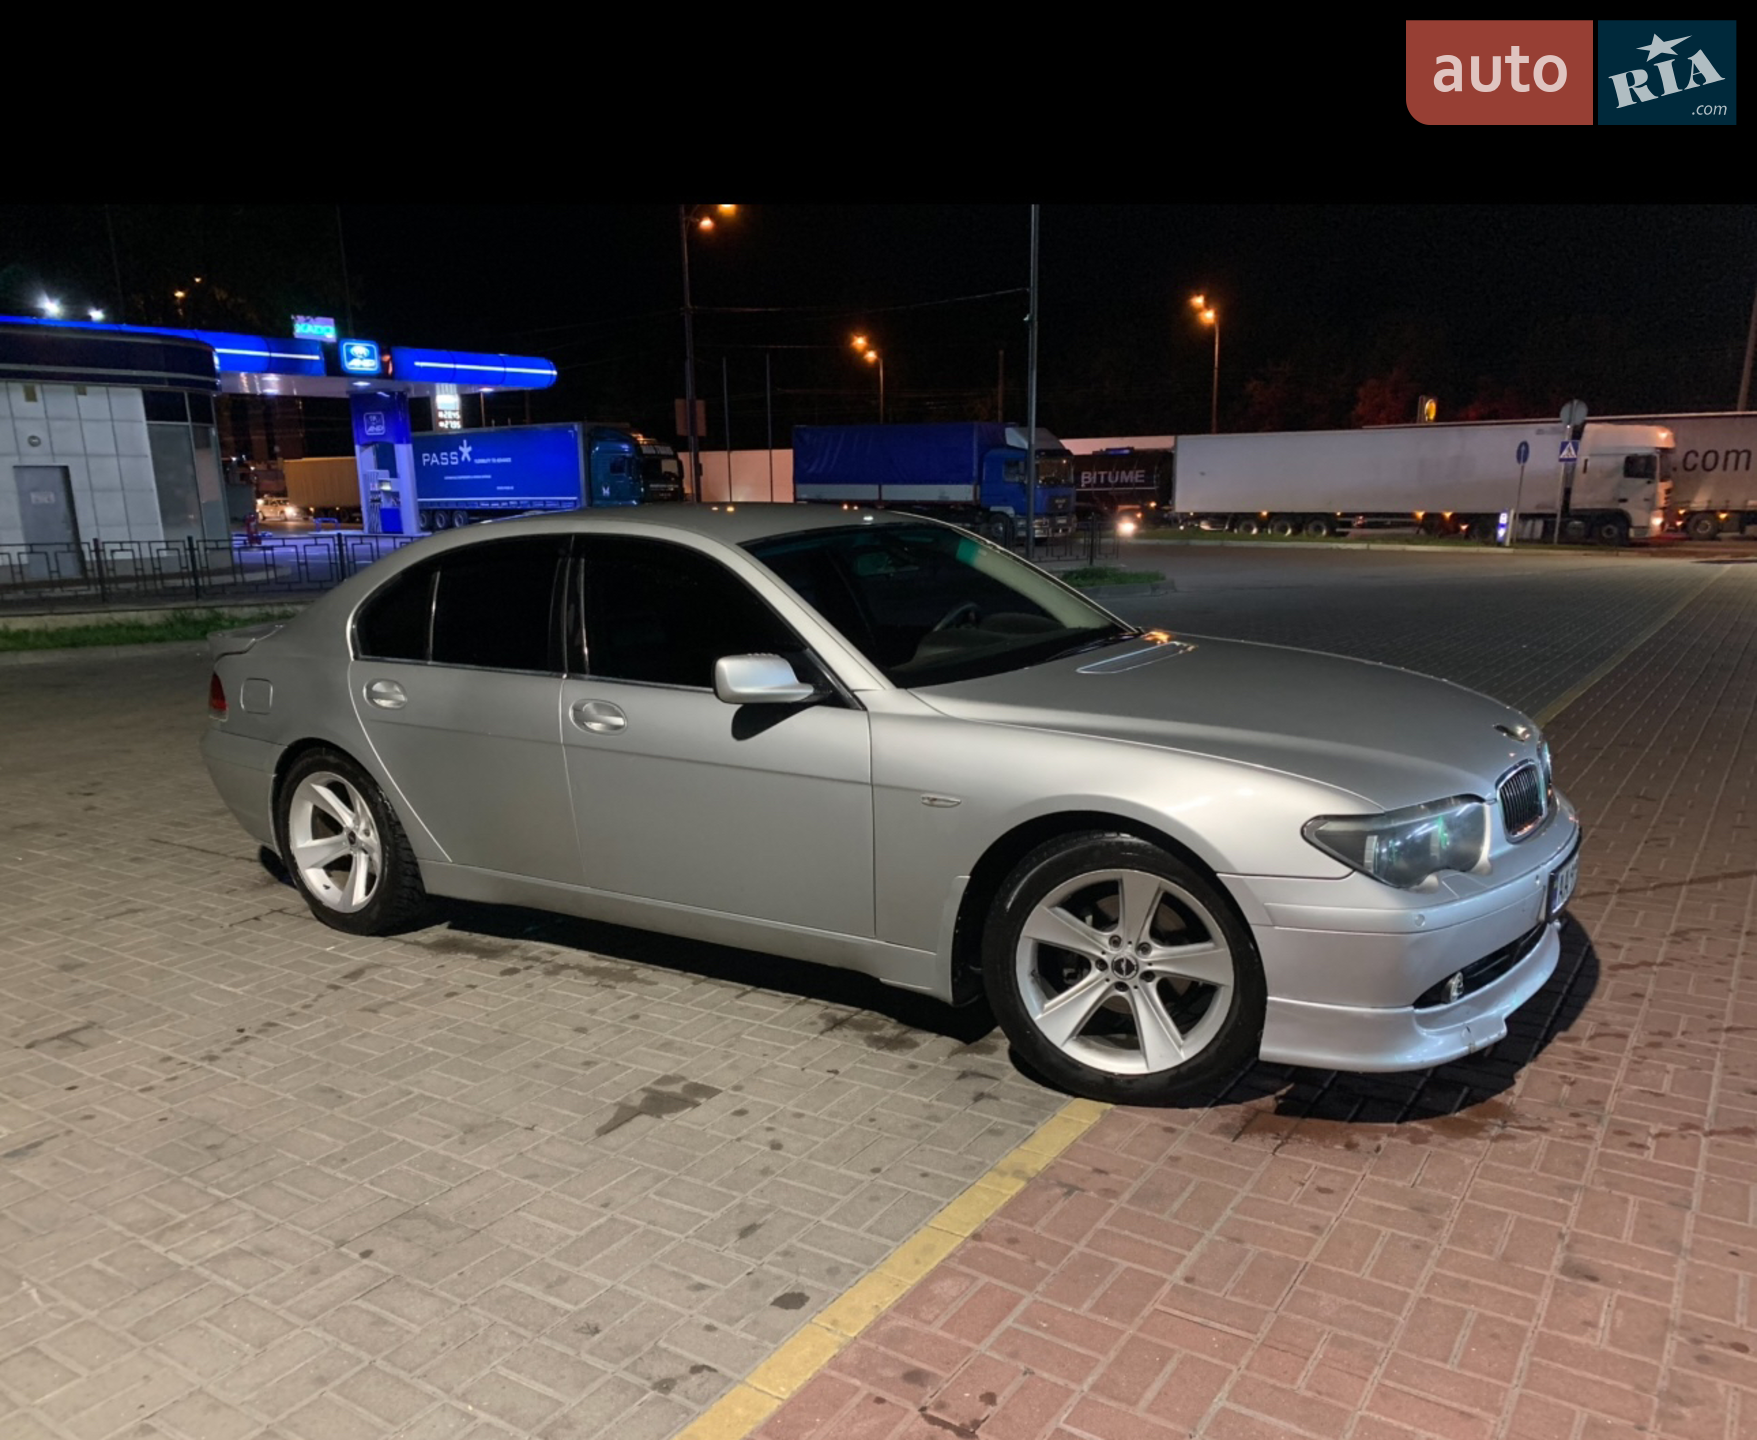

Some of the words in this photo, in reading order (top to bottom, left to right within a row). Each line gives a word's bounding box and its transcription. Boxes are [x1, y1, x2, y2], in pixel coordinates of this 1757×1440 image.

[422, 451, 459, 466] PASS
[1672, 449, 1752, 472] .com
[1081, 470, 1145, 487] BITUME
